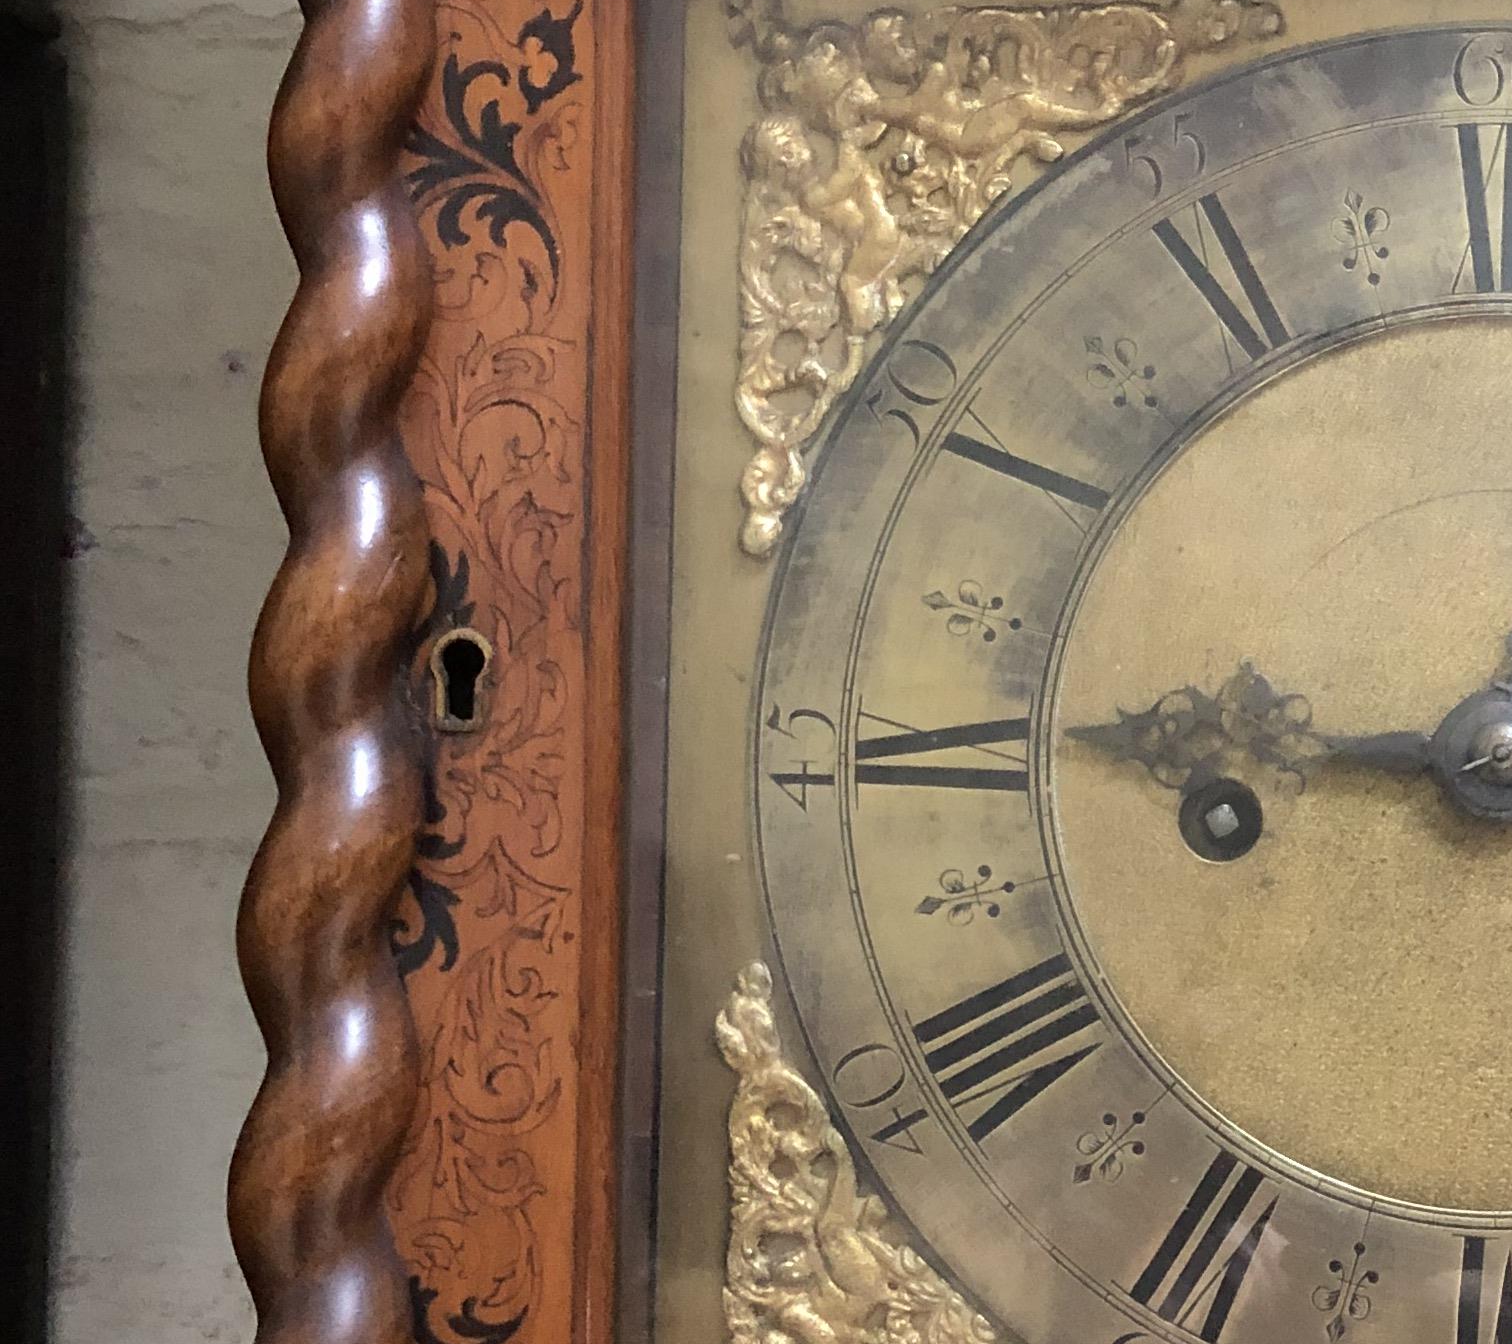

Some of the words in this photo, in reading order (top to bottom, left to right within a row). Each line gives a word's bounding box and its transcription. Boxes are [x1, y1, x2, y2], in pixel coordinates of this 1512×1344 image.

[1123, 109, 1206, 202] 55
[1146, 184, 1305, 376] XI
[867, 339, 957, 453] 50
[930, 391, 1120, 539] X
[767, 703, 837, 812] 45
[854, 698, 1034, 813] IX
[832, 1043, 929, 1155] 40
[907, 934, 1108, 1154] VIII
